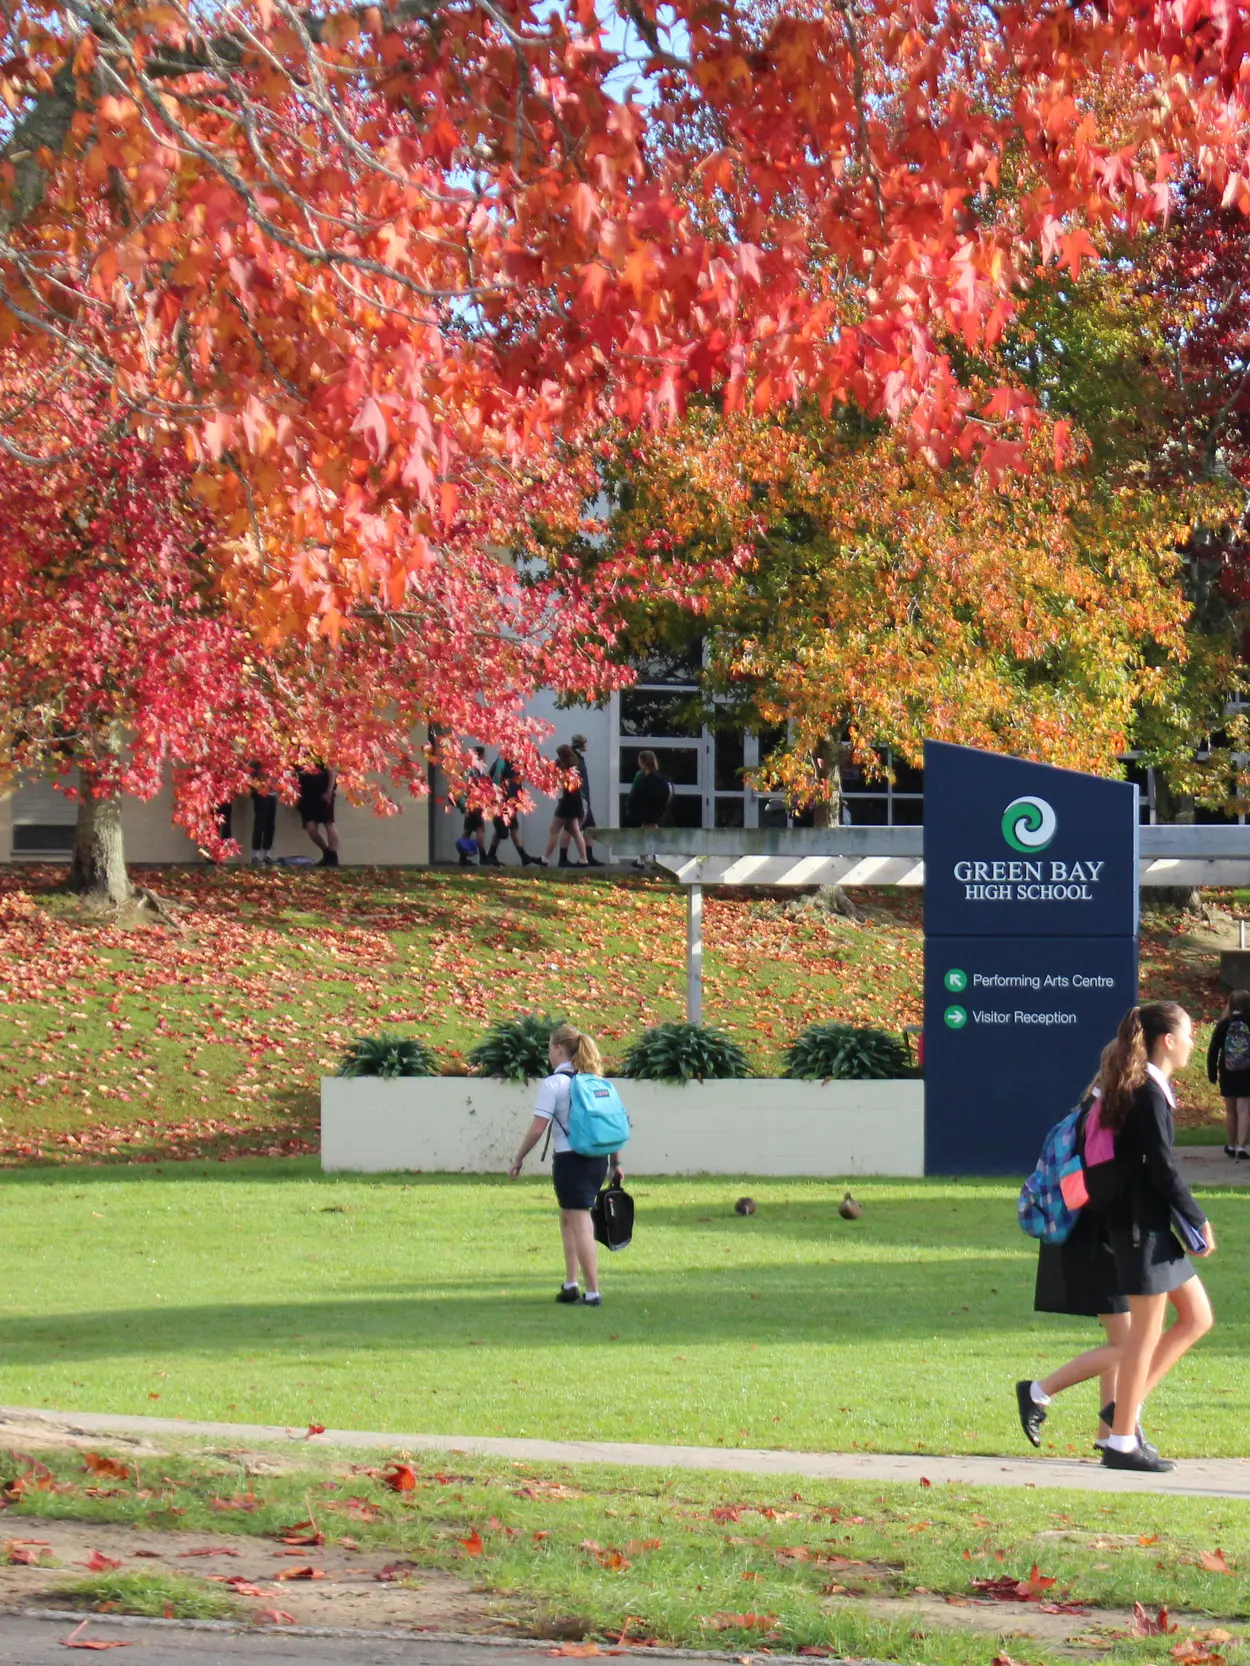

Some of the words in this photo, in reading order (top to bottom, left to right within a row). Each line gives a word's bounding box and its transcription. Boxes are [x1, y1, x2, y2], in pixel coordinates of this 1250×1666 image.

[953, 860, 1044, 882] GREEN
[1050, 860, 1105, 882] BAY
[964, 884, 1013, 901] HIGH
[1016, 884, 1093, 901] SCHOOL
[972, 973, 1041, 989] Performing
[1043, 973, 1070, 988] Arts
[1072, 973, 1115, 988] Centre
[972, 1010, 1011, 1024] Visitor
[1014, 1010, 1077, 1026] Reception
